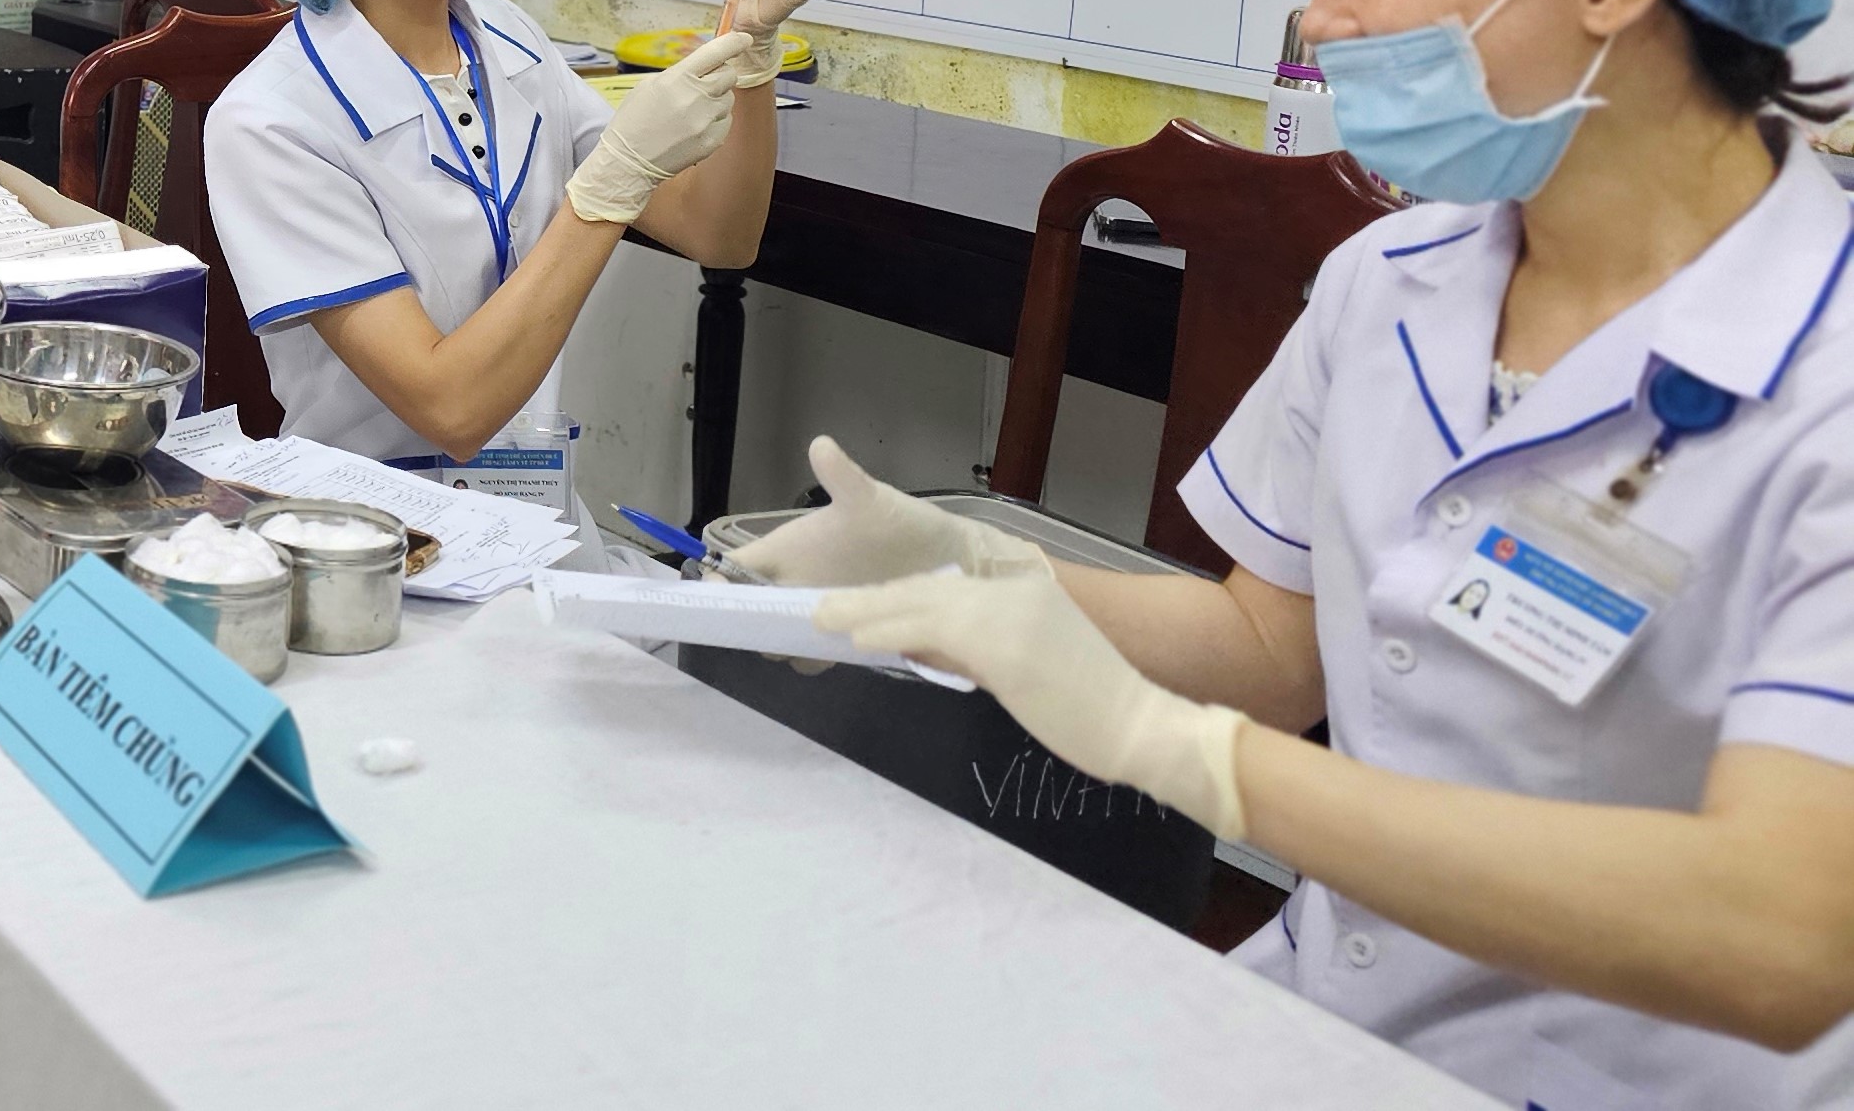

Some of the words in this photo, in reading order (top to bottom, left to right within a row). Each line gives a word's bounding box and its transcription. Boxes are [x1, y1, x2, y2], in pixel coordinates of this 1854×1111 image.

[14, 624, 68, 678] BÀN
[58, 661, 123, 733] TIÊM
[112, 714, 206, 808] CHỦNG
